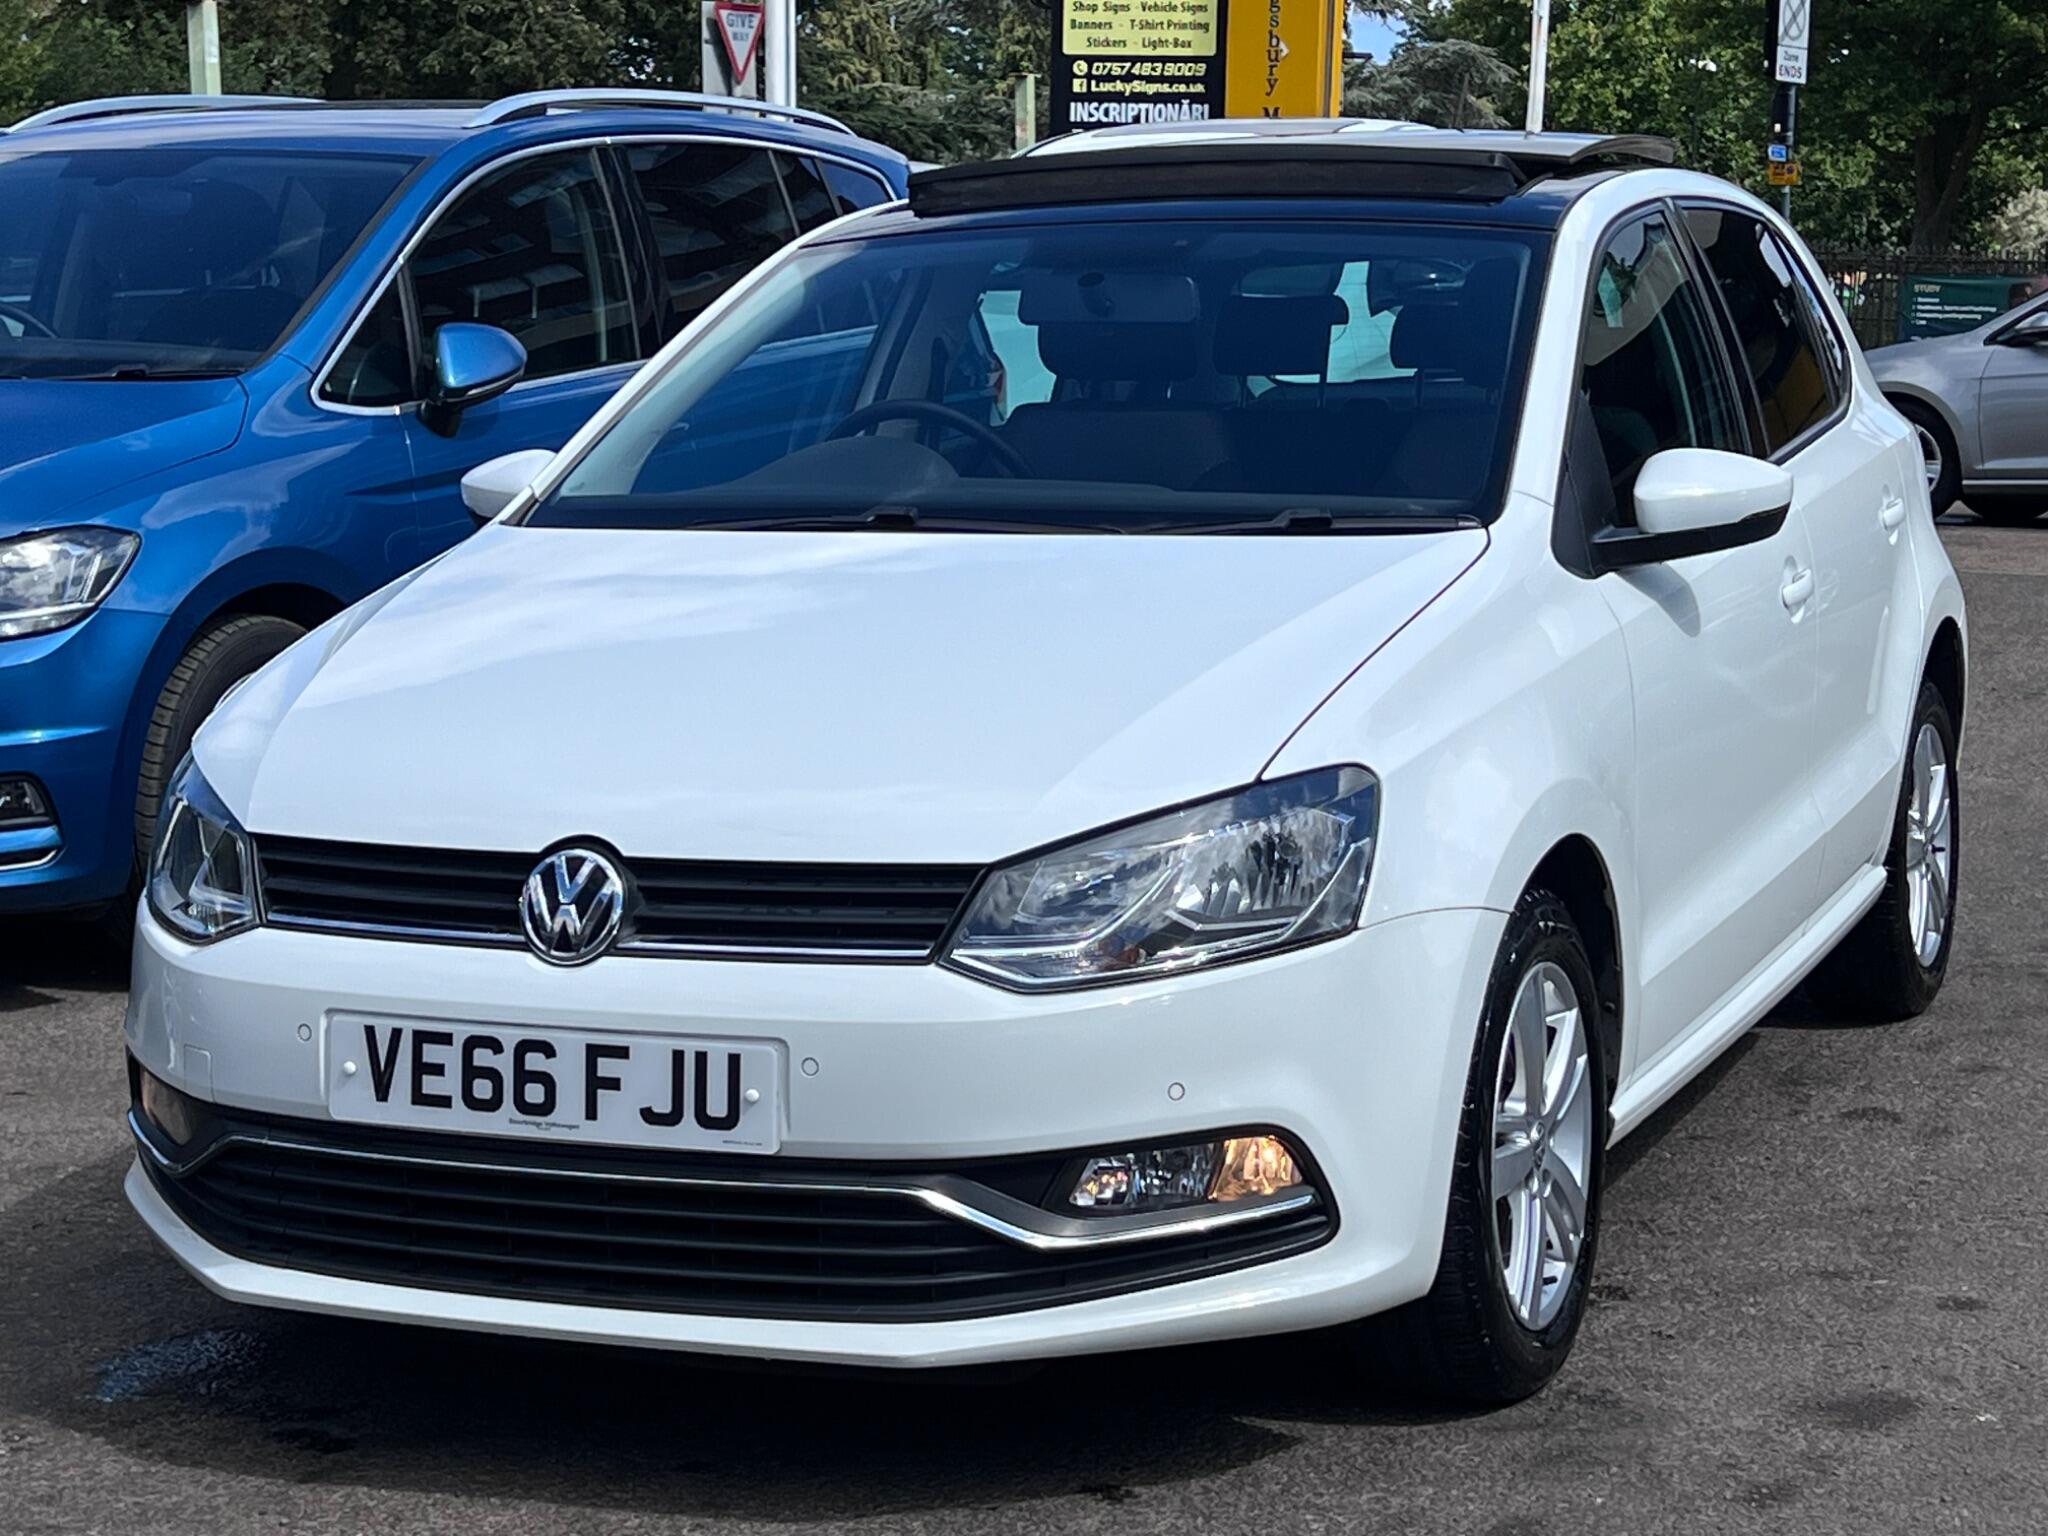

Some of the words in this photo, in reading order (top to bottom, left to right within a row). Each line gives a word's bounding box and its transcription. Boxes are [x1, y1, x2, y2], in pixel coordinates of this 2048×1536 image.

[1072, 1, 1098, 13] Shop
[1102, 1, 1131, 14] Signs
[1140, 1, 1178, 12] Vehicle
[1180, 1, 1209, 15] Signs
[726, 12, 755, 29] GIVE
[1070, 18, 1113, 30] Banners
[1129, 19, 1165, 31] T-Shirt
[1166, 20, 1210, 33] Printing
[1086, 36, 1127, 48] Stickers
[1141, 37, 1193, 50] Light-Box
[1091, 62, 1132, 75] 0757
[1778, 64, 1802, 79] ENDS
[1090, 79, 1206, 96] LuckySigns.co.uk
[363, 1024, 558, 1117] VE66
[584, 1043, 742, 1131] FJU
